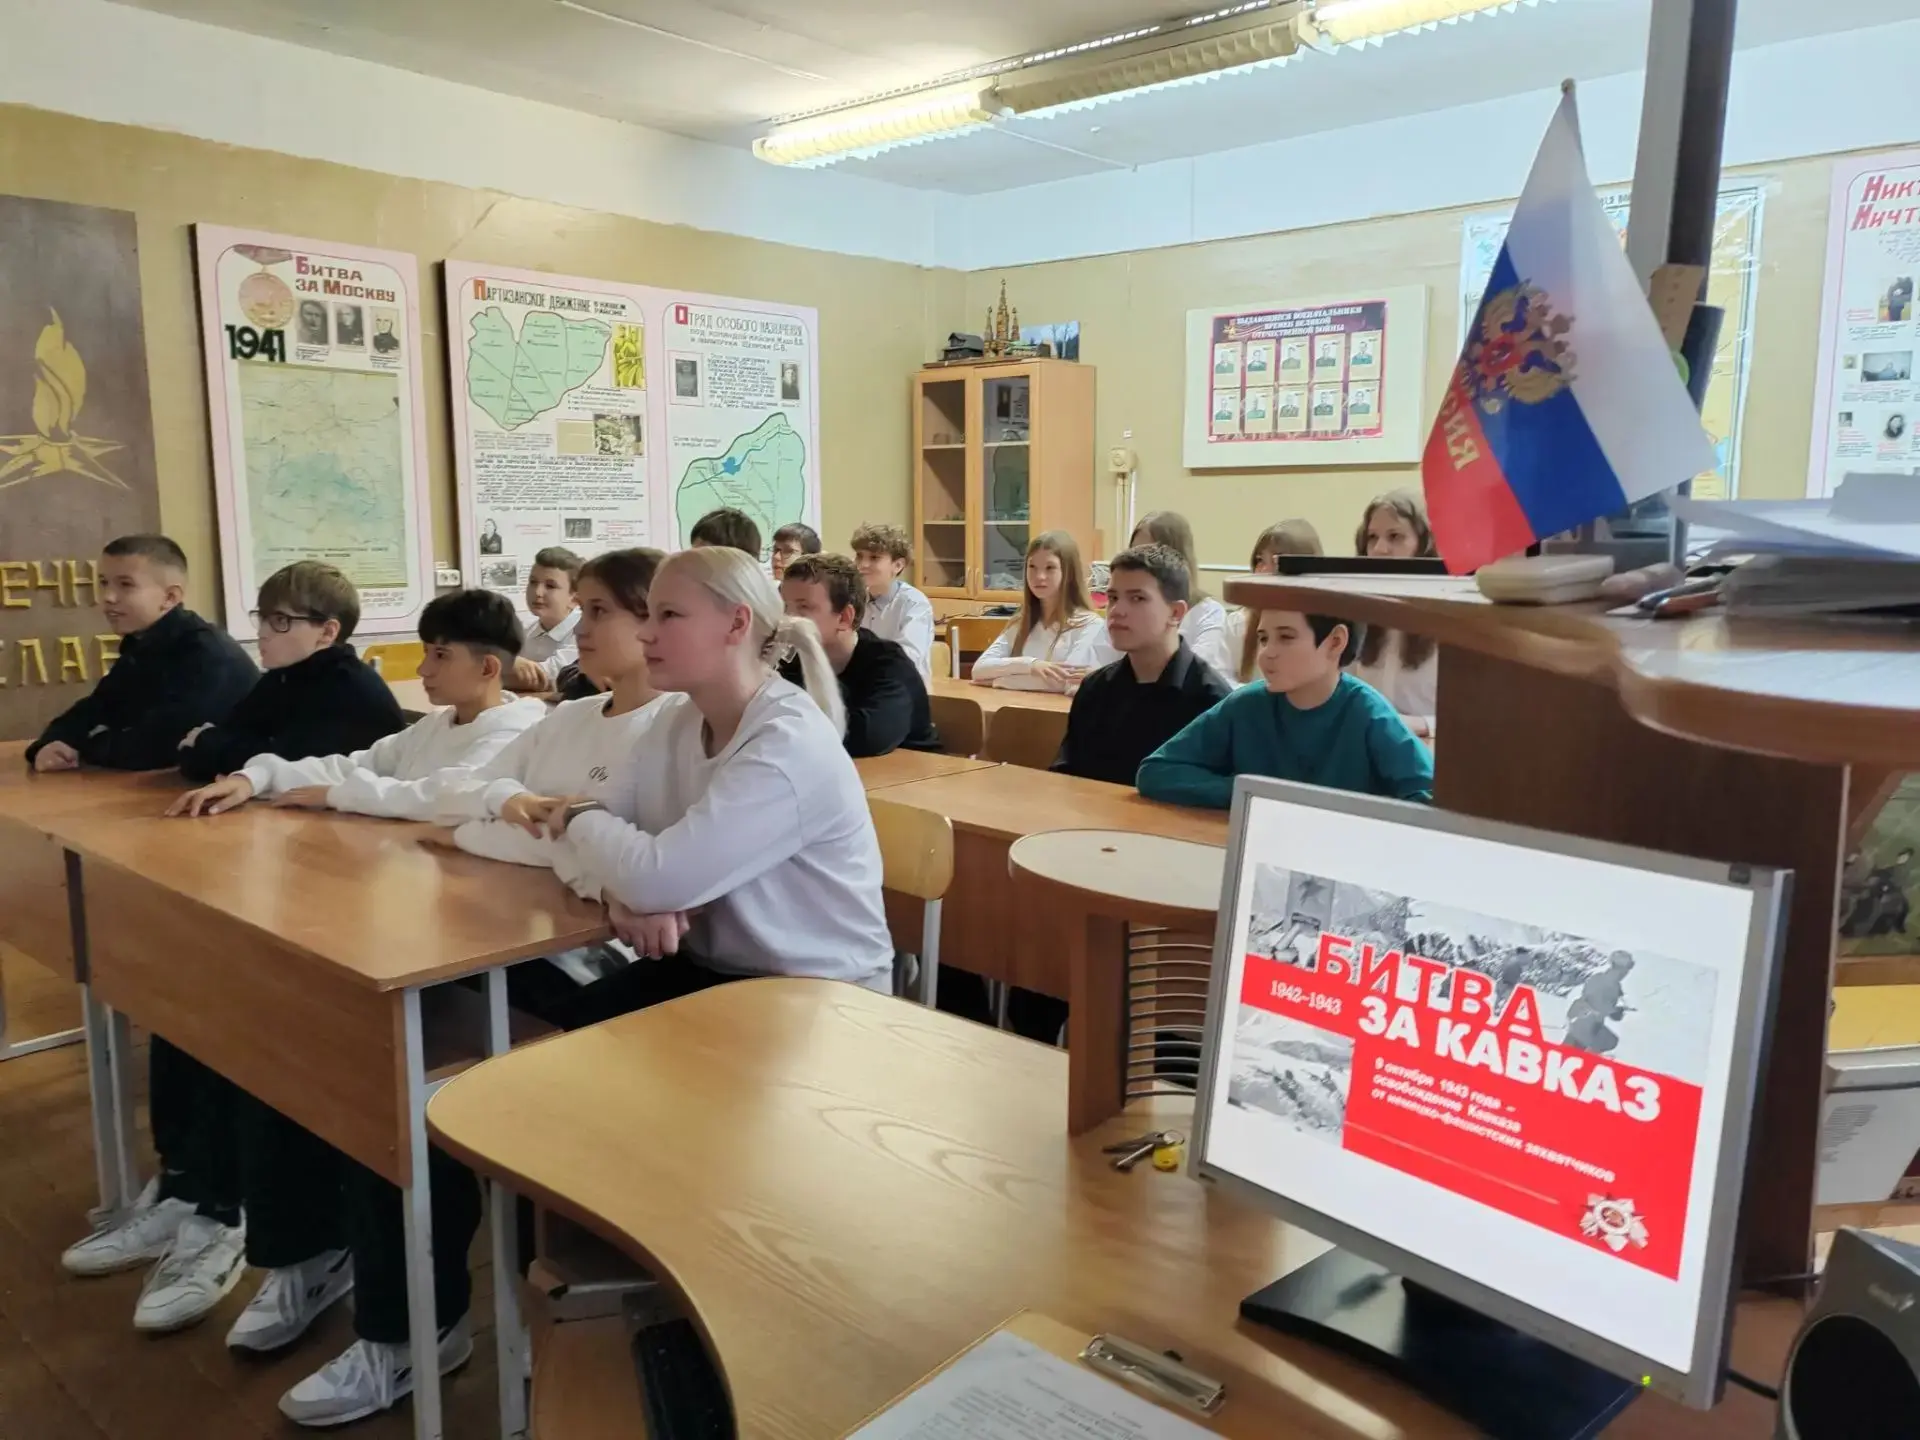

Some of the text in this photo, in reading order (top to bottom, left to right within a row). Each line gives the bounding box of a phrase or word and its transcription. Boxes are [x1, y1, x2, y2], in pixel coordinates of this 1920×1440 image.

[1851, 203, 1920, 231] НИЧТ
[295, 256, 364, 282] БИТВА
[295, 278, 396, 302] ЗА МОСКВУ
[473, 279, 590, 312] ПАРТИЗАНСКОЕ ДВИЖЕНИЕ
[675, 305, 803, 336] ОТРЯД ОСОБОГО НАЗНАЧЕНИЯ
[224, 324, 286, 362] 1941
[1314, 930, 1558, 1045] БИТВА
[1358, 995, 1661, 1122] ЗА КАВКАЗ
[1374, 1057, 1384, 1070] 9
[1384, 1063, 1434, 1087] октября
[1439, 1079, 1470, 1099] 1943
[1470, 1091, 1501, 1110] года
[1372, 1074, 1522, 1134] освобождение Кавказа
[1371, 1088, 1386, 1100] от
[1524, 1142, 1616, 1184] захватчиков
